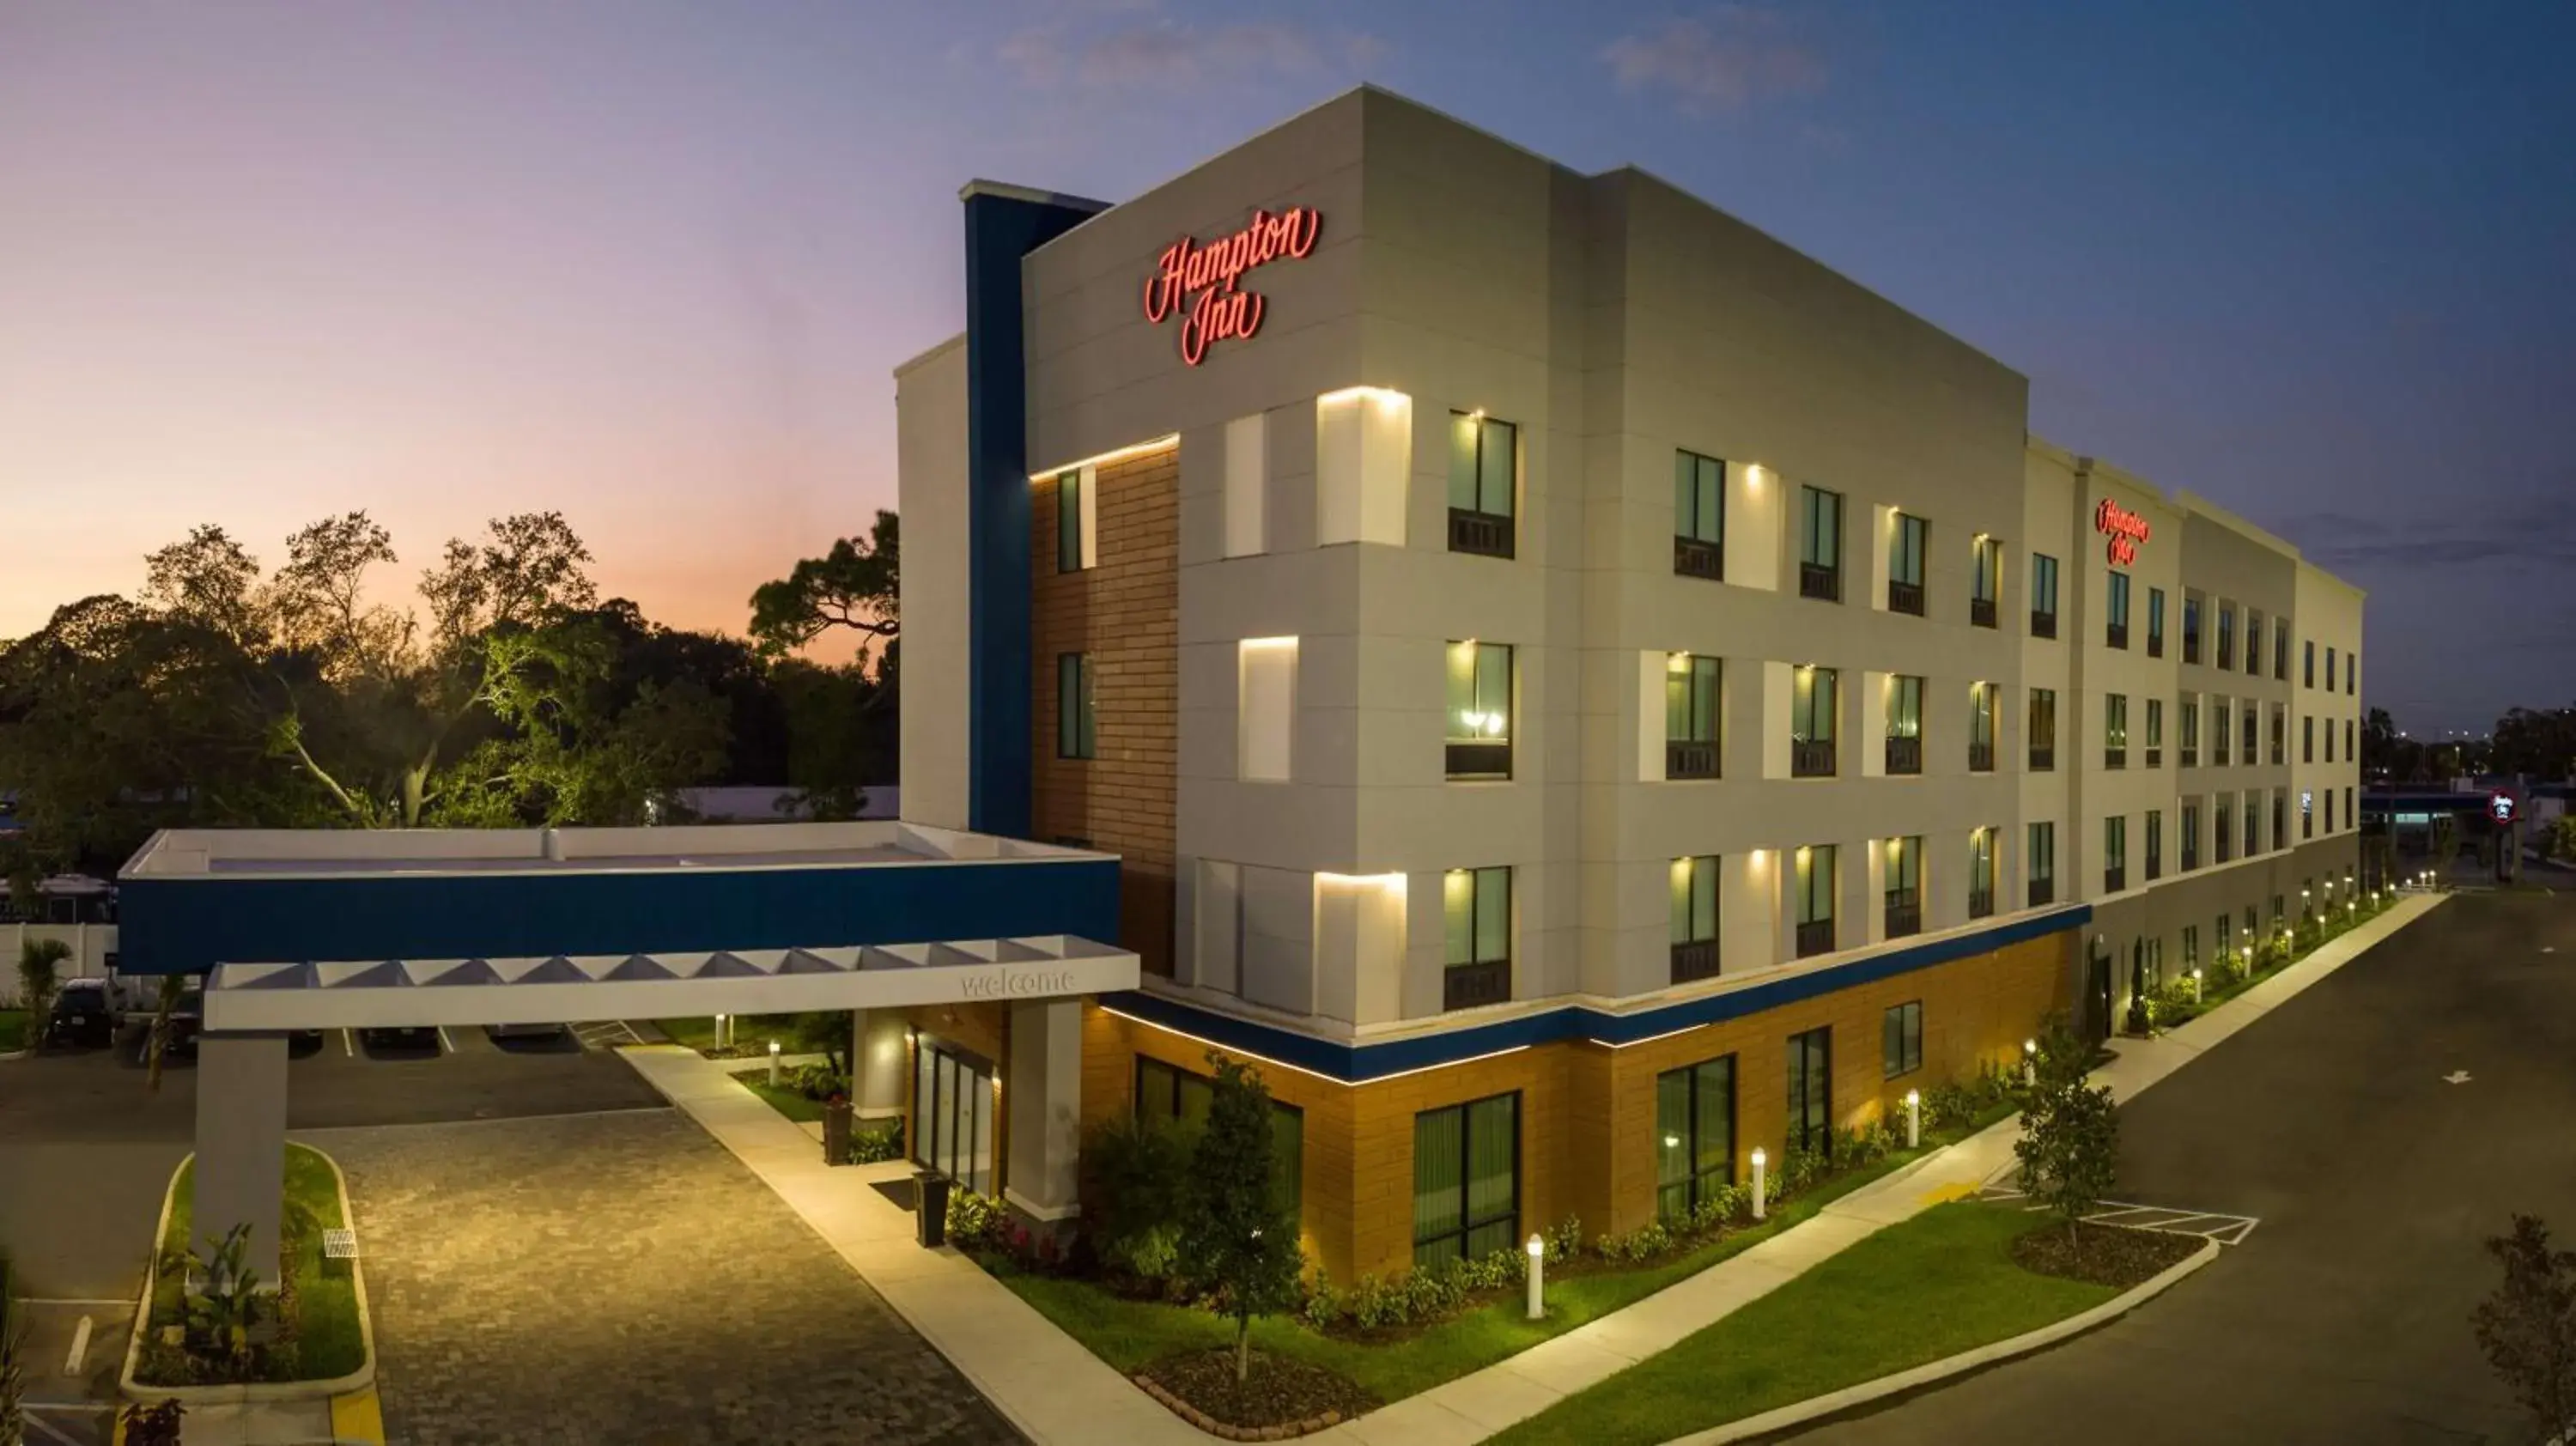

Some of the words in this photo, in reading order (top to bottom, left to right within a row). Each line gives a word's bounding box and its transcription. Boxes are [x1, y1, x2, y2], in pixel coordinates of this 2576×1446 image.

[1145, 206, 1321, 324] Hampton
[1182, 285, 1264, 366] Inn
[961, 967, 1075, 997] welcome
